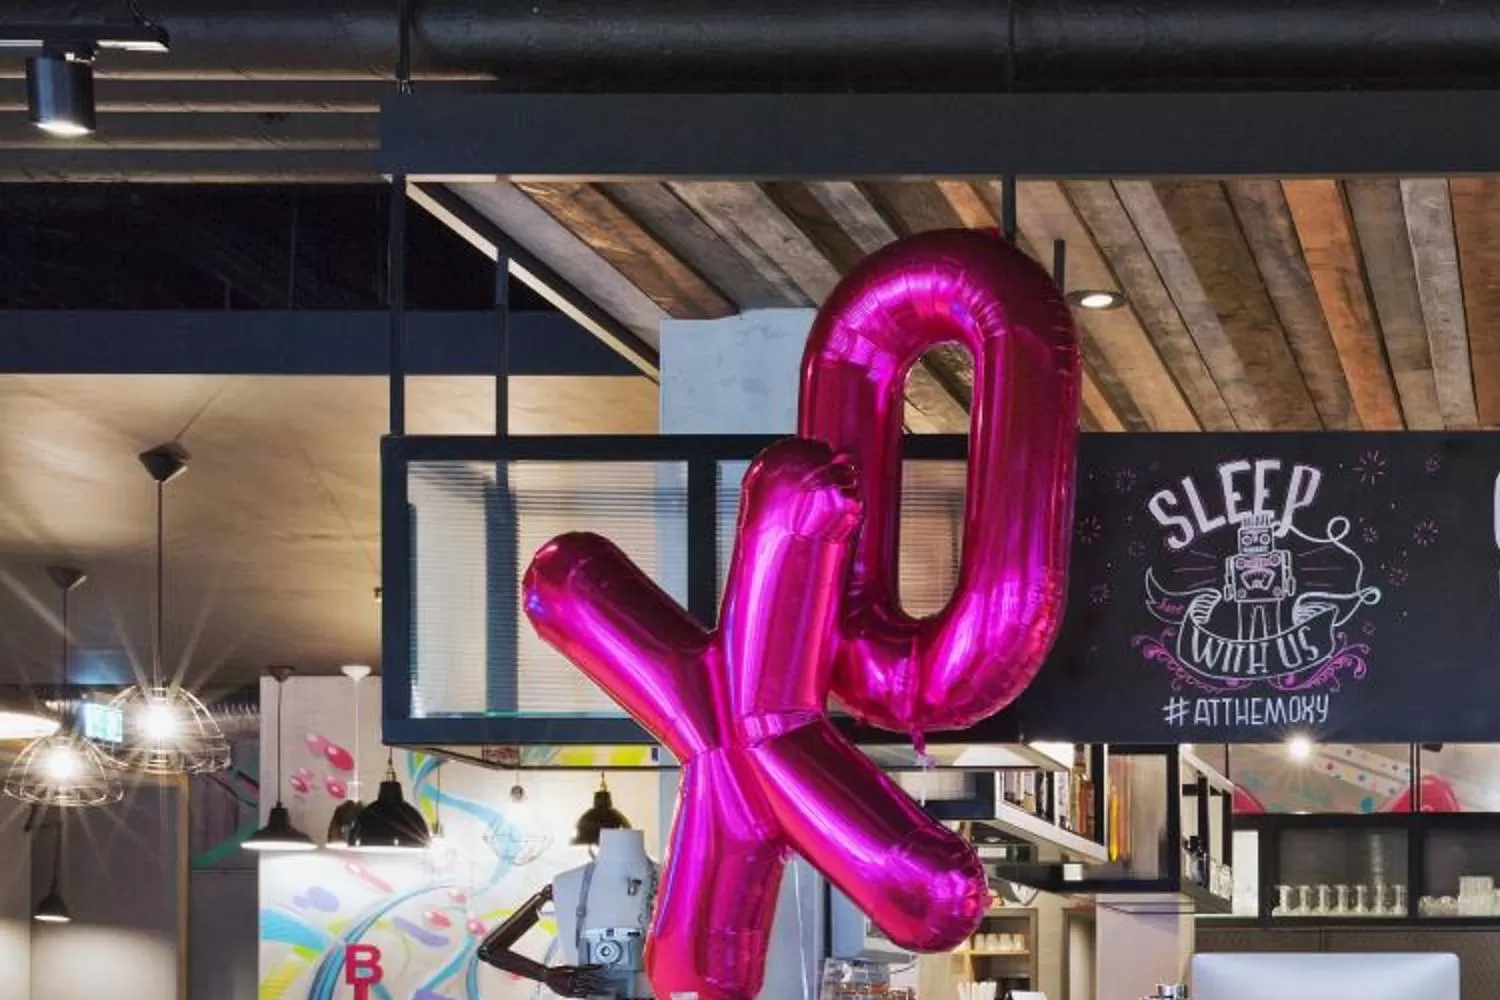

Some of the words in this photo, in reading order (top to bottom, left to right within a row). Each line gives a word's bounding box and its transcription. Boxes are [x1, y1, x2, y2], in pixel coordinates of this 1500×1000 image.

[1148, 459, 1321, 549] SLEEP
[1191, 626, 1268, 674] WITH
[1278, 625, 1319, 669] US
[1163, 694, 1330, 727] #ATTHEMOXY
